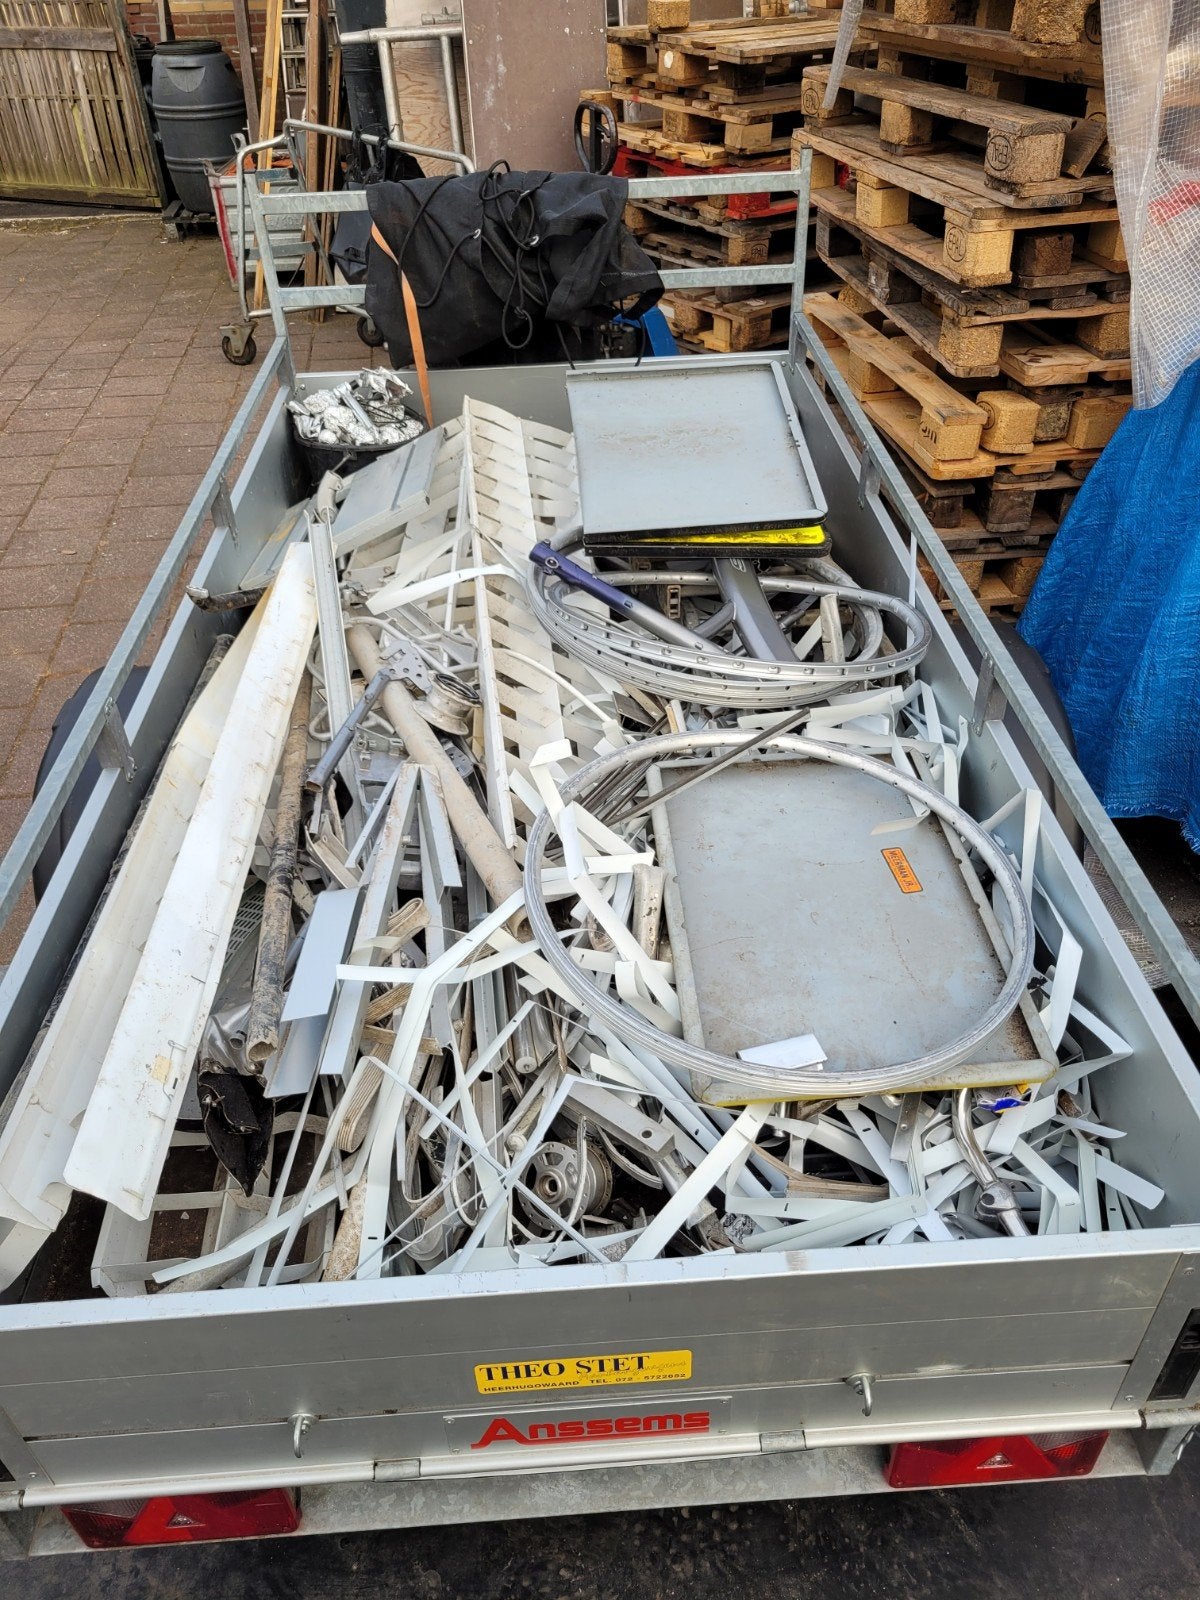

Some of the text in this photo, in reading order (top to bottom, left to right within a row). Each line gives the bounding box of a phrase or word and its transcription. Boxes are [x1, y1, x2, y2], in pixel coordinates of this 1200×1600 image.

[479, 1362, 565, 1381] THEO
[575, 1355, 650, 1374] STET
[483, 1380, 580, 1392] HEERHUGOWAARD
[470, 1410, 710, 1450] Anssems
